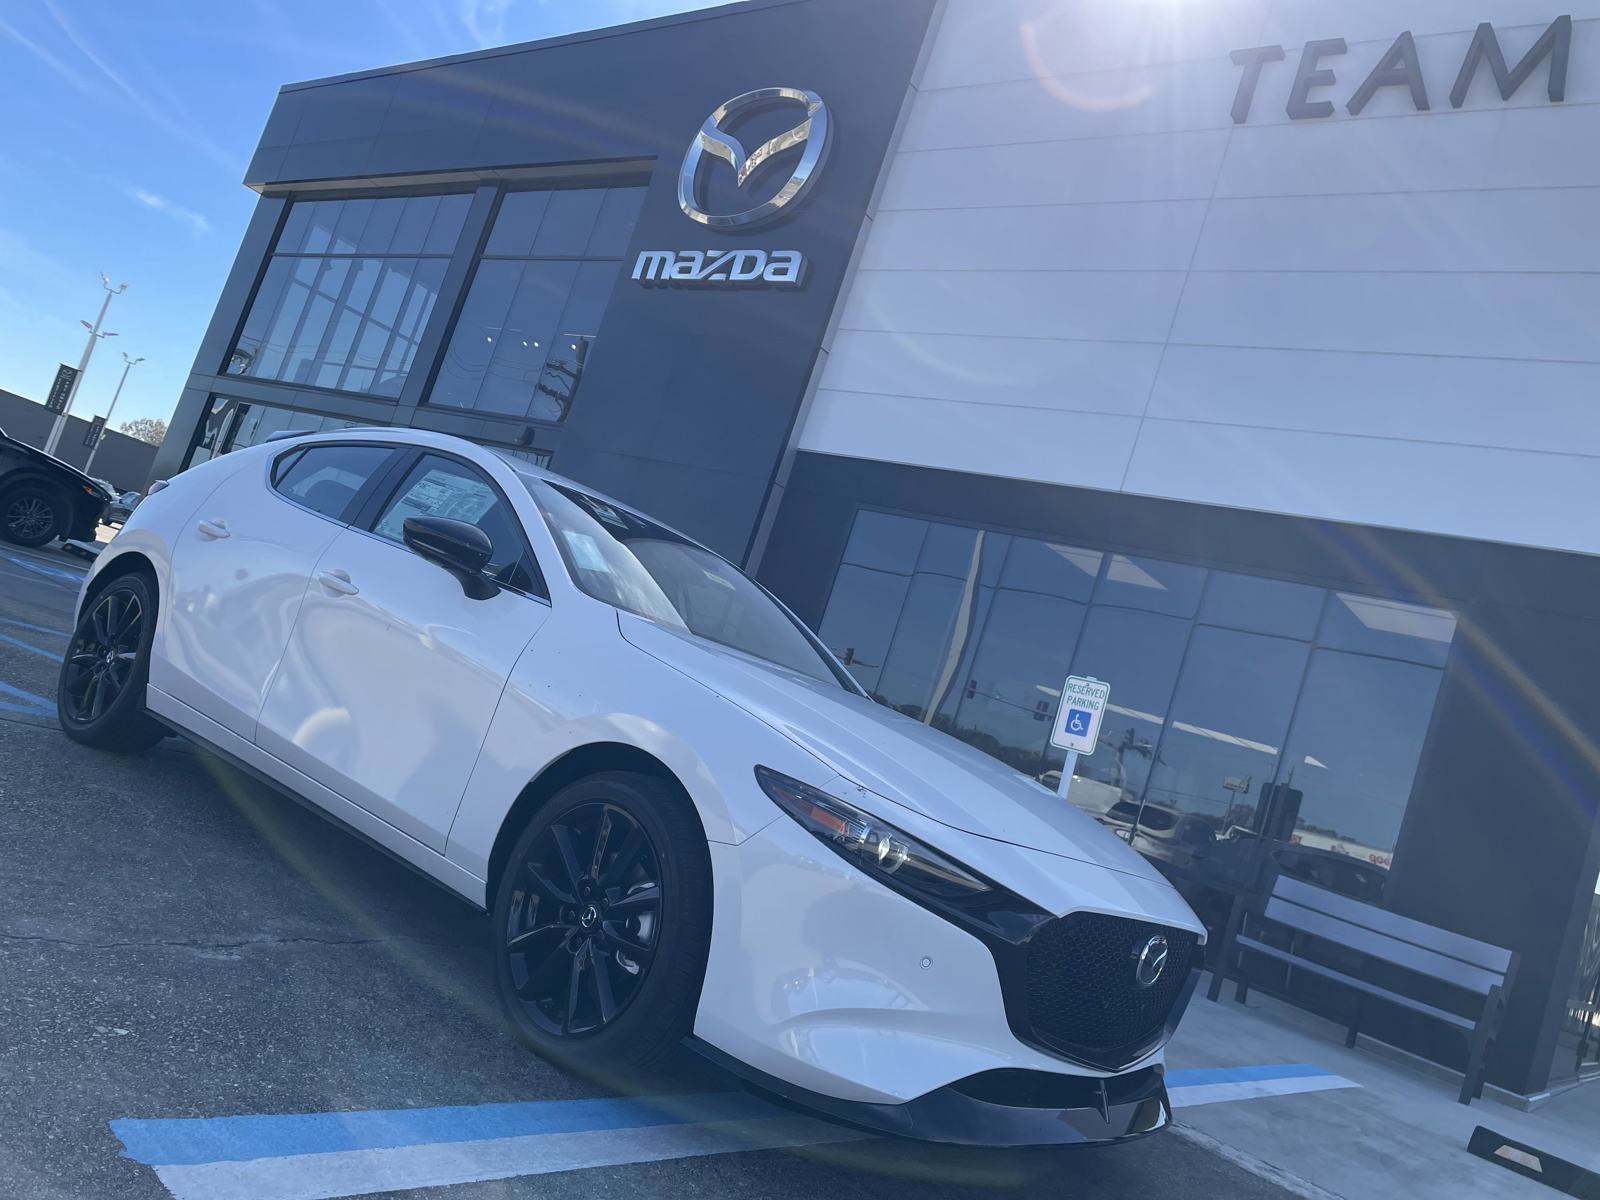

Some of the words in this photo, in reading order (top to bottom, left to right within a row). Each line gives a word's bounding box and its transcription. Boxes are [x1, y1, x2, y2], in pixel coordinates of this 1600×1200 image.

[1229, 14, 1572, 124] TEAM
[1067, 683, 1106, 699] RESERVED
[1066, 695, 1100, 711] PARKING
